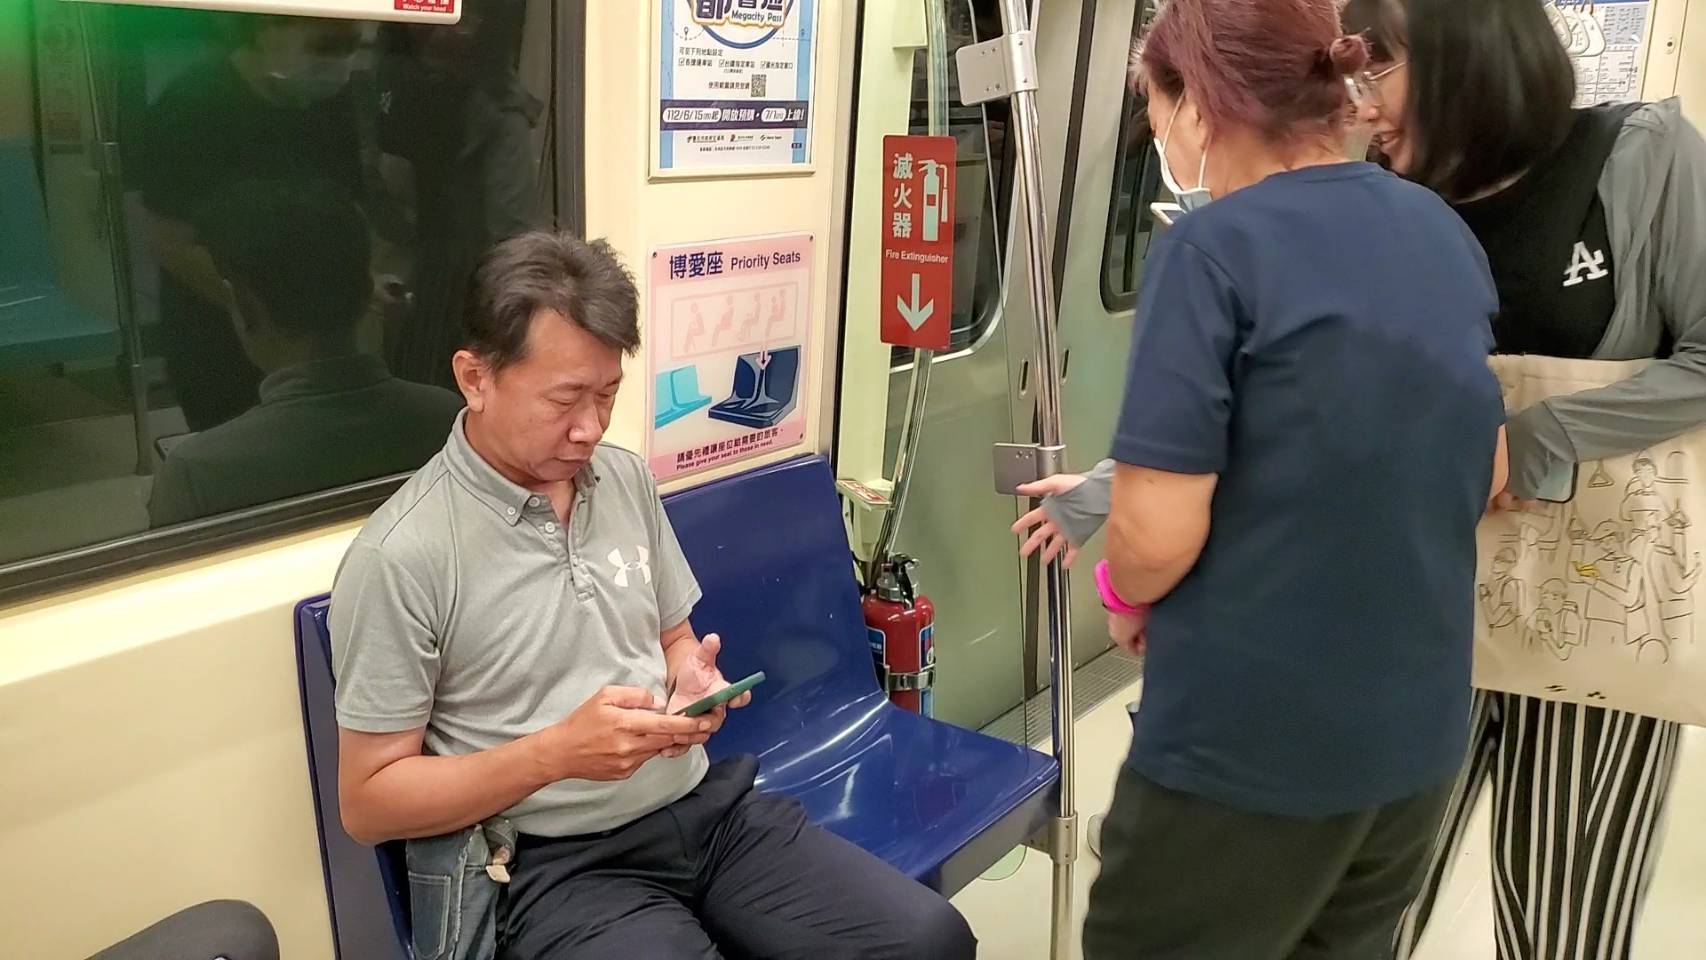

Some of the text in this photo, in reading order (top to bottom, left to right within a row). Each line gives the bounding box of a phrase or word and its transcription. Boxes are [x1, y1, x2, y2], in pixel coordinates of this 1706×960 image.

[731, 10, 782, 22] Megacity Pass
[892, 152, 913, 239] 滅火器
[669, 250, 801, 280] 博愛座 Priority Seats
[885, 249, 949, 264] Fire Extinguisher
[676, 462, 695, 471] Please
[696, 458, 707, 467] give
[708, 454, 720, 464] your
[721, 450, 732, 459] seat
[739, 445, 754, 454] those
